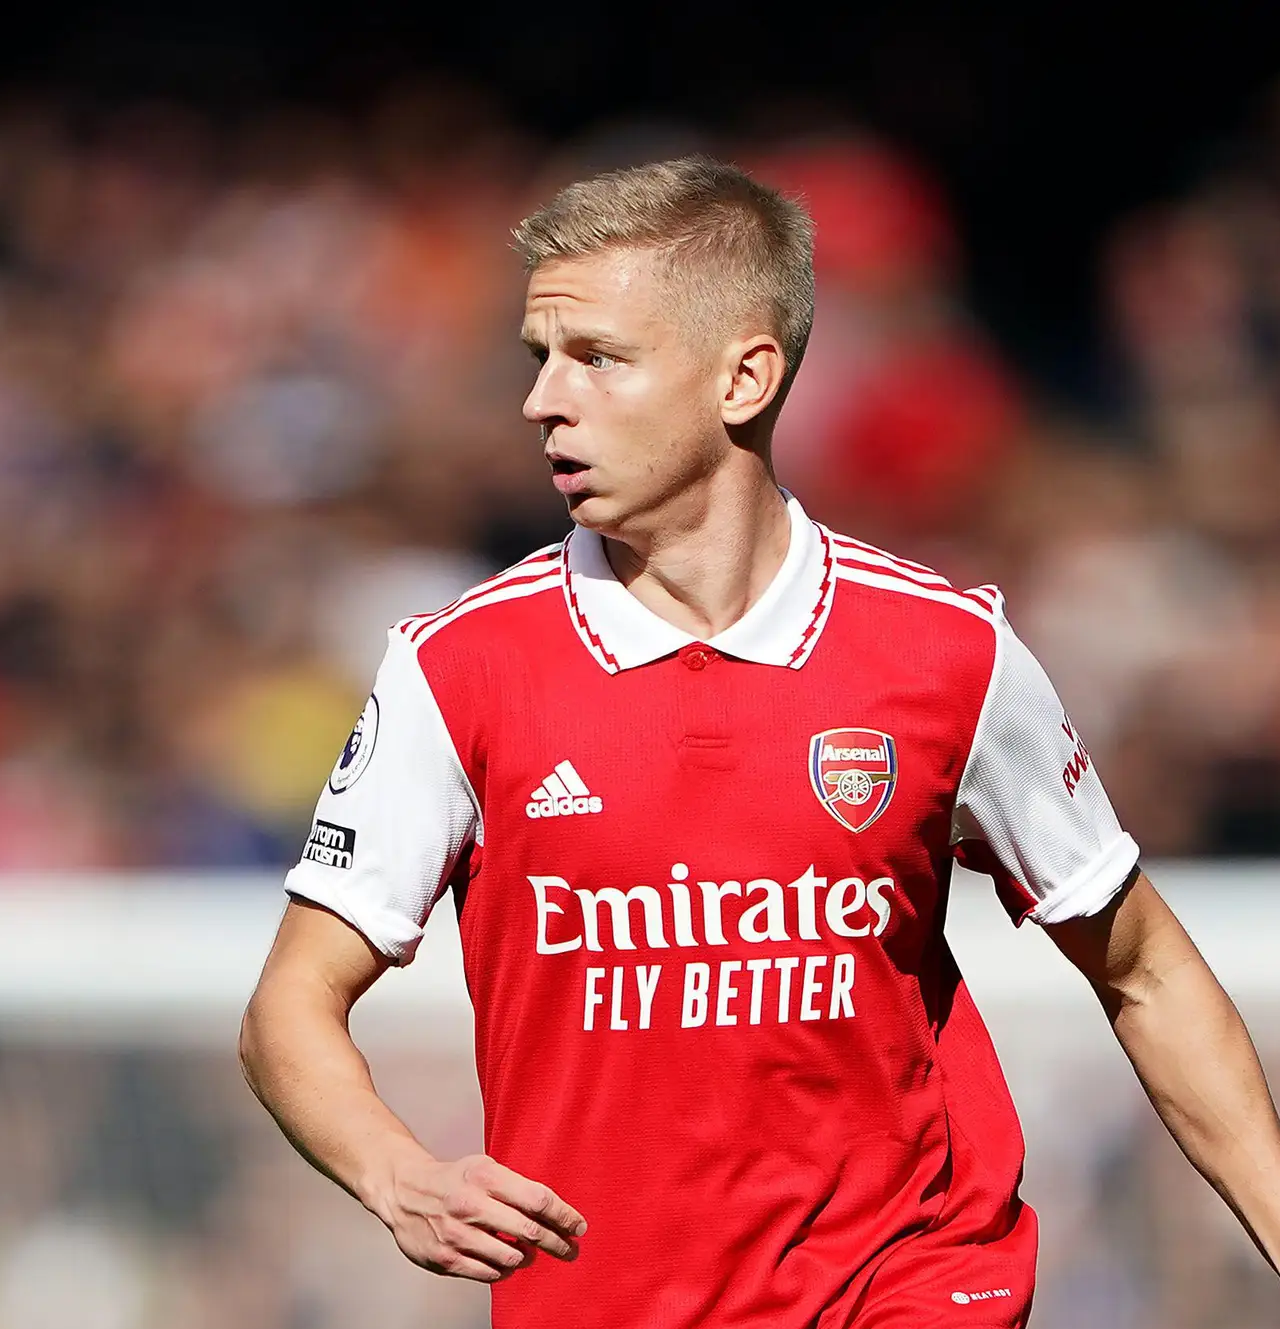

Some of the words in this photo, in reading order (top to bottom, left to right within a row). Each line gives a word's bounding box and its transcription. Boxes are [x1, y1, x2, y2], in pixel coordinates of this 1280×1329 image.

[821, 744, 886, 762] Arsenal
[525, 795, 603, 819] adidas
[526, 862, 895, 955] Emirates
[583, 965, 662, 1031] FLY
[680, 953, 856, 1029] BETTER
